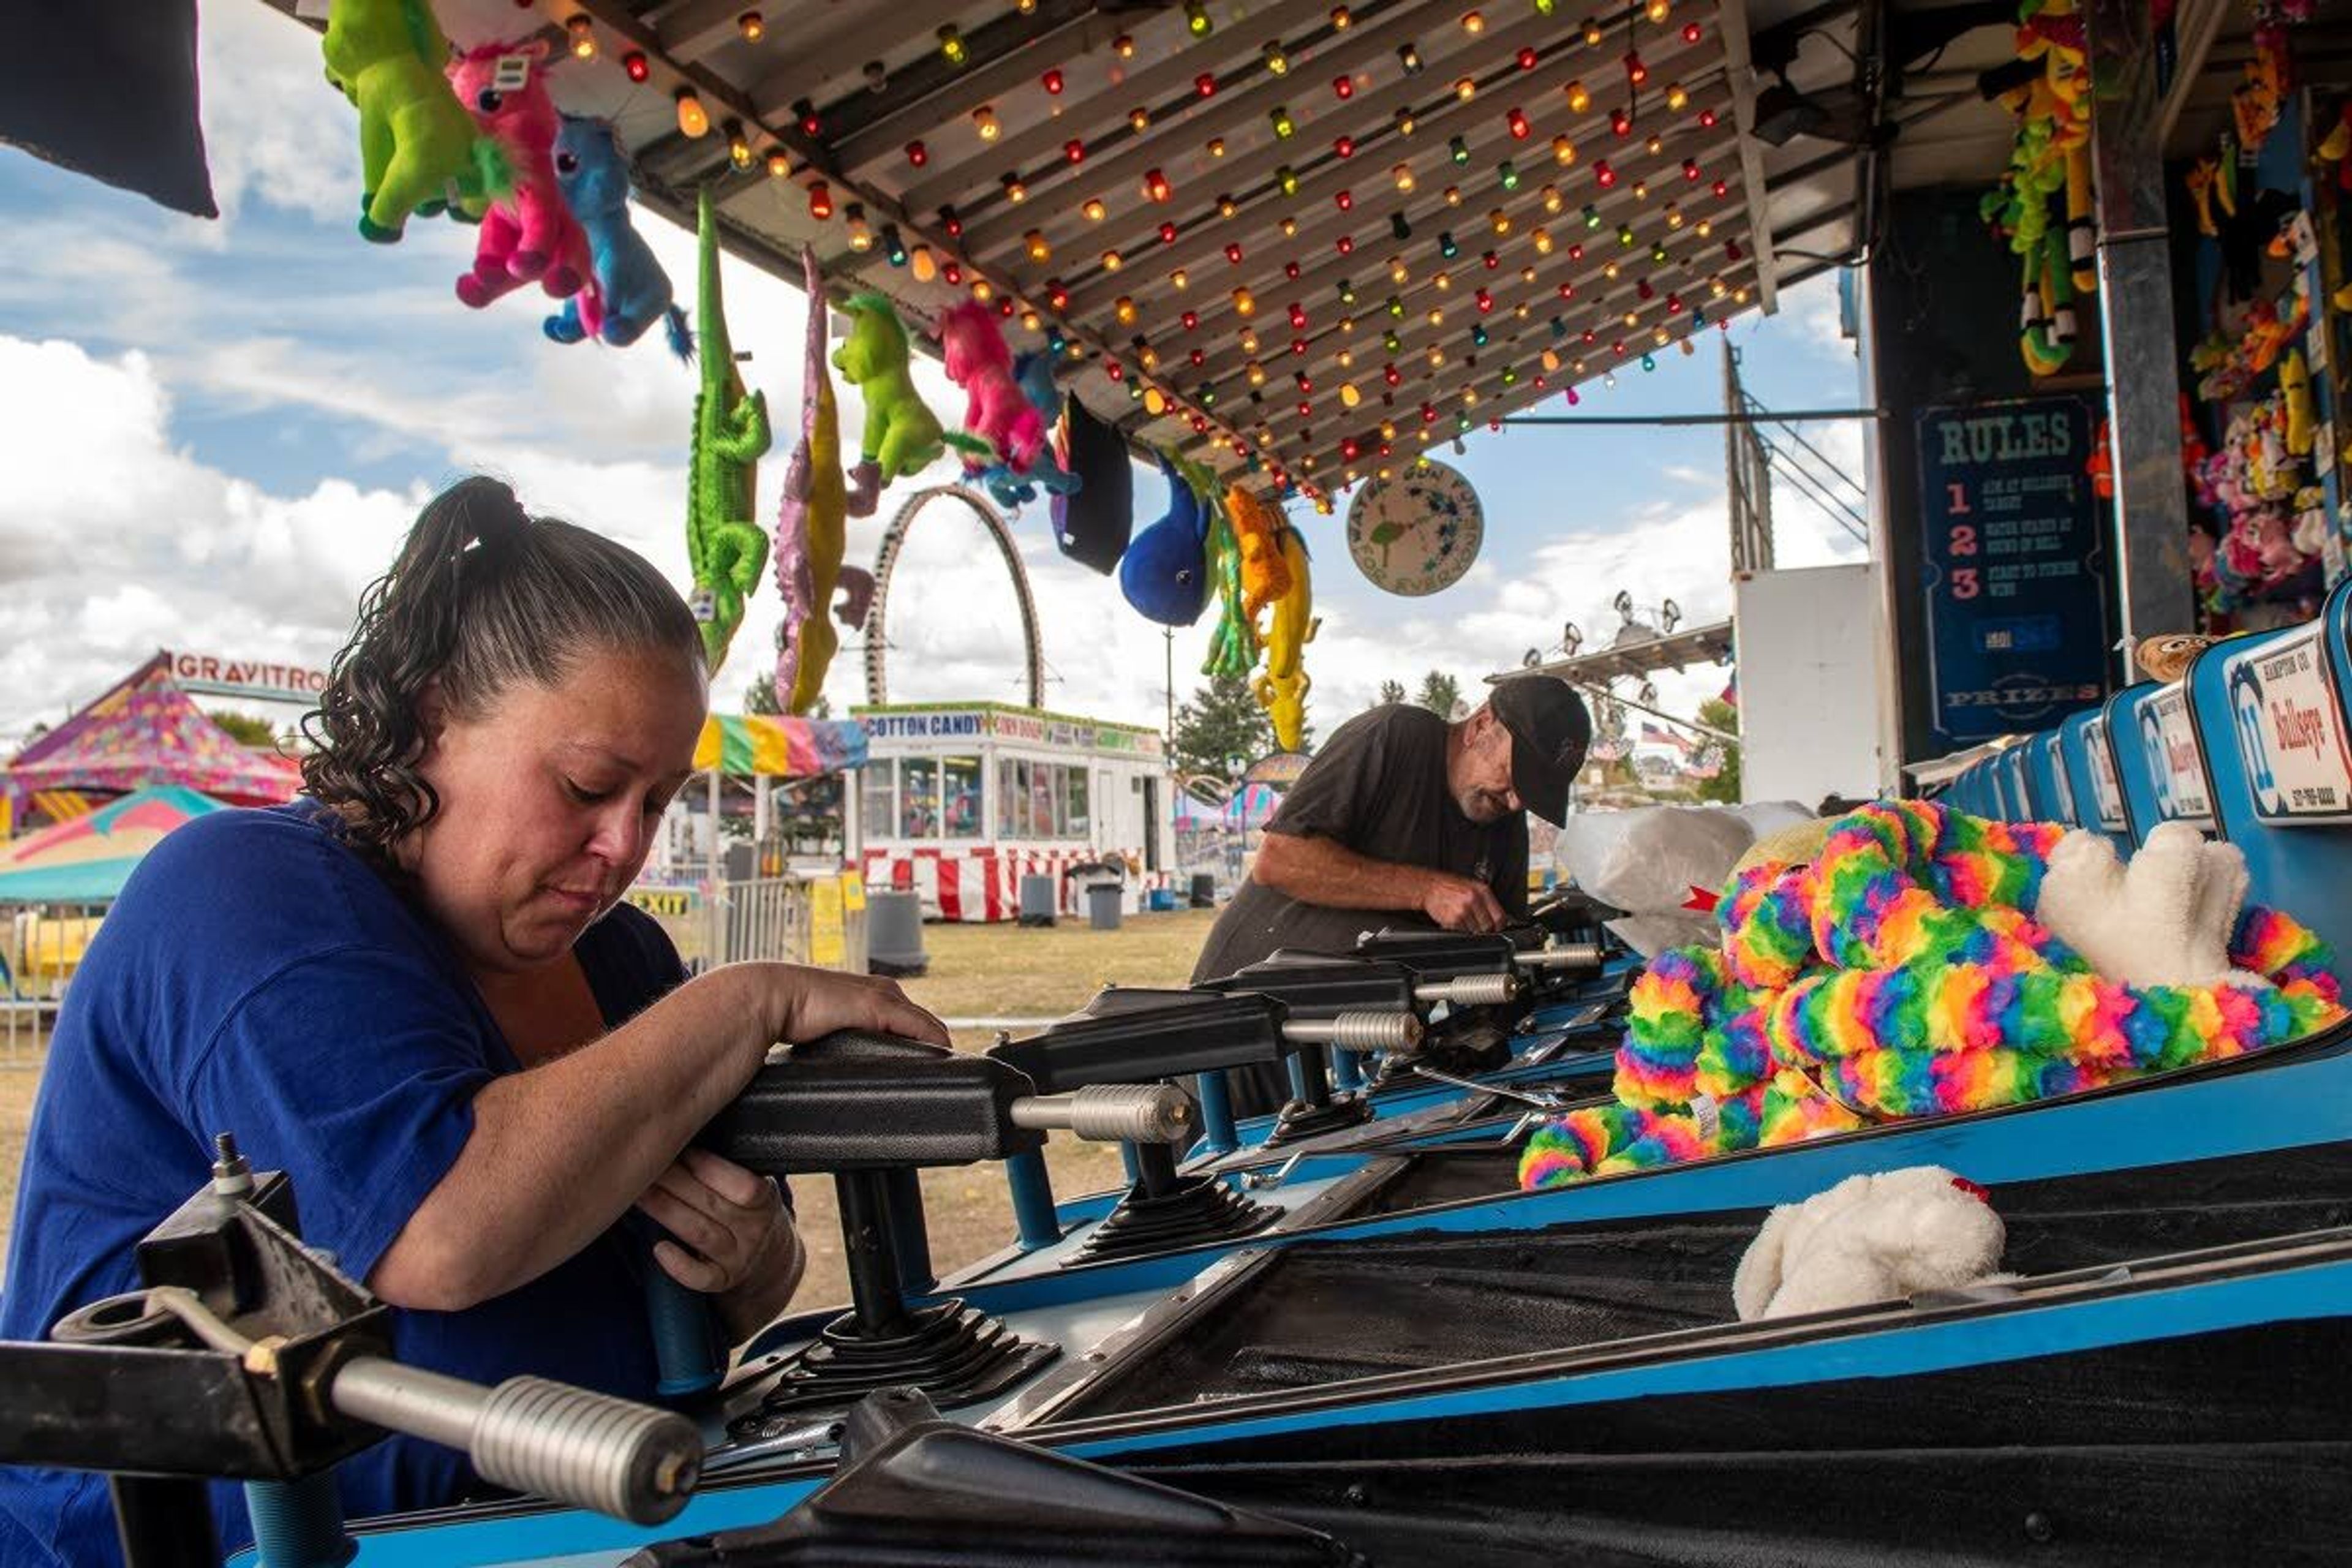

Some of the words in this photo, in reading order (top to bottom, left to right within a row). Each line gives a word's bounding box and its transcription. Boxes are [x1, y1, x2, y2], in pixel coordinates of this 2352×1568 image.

[1939, 413, 2070, 464] RULES
[1947, 483, 1971, 513] 1
[1948, 525, 1978, 556] 2
[1952, 568, 1979, 599] 3
[178, 654, 328, 692] GRAVITRO
[1945, 683, 2101, 706] PRIZES
[866, 717, 927, 737] COTTON
[930, 714, 982, 736] CANDY
[2271, 697, 2326, 761] Bullseye
[633, 894, 685, 914] EXIT
